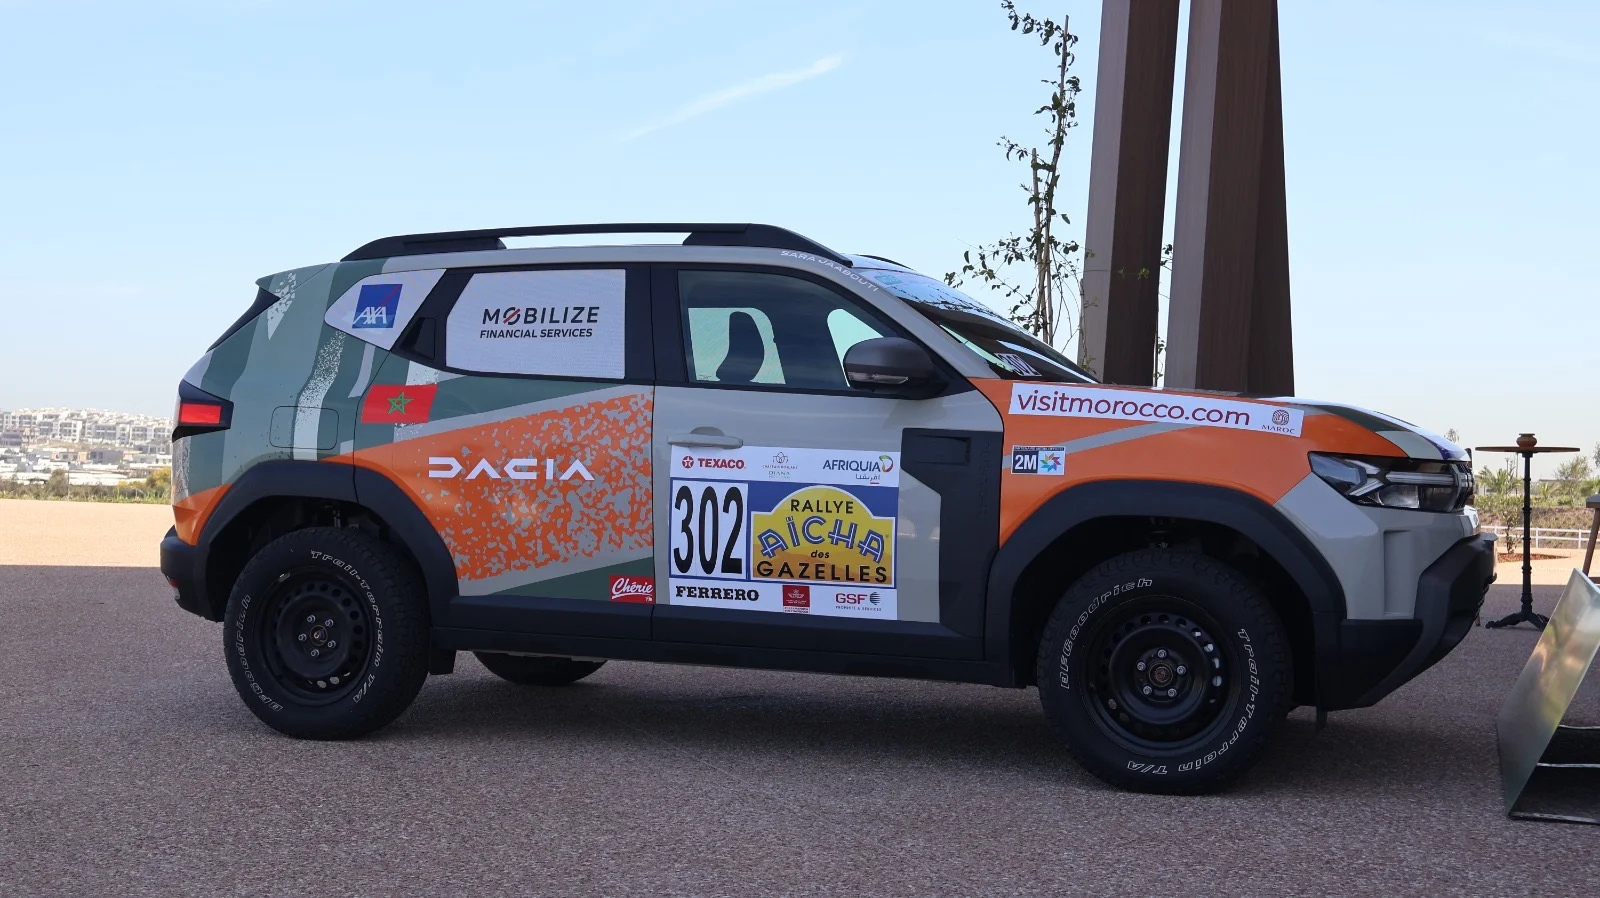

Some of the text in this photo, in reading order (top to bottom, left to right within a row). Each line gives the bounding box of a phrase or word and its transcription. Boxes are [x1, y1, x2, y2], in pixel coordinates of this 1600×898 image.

[781, 250, 815, 262] SARA
[353, 306, 388, 325] AXA
[482, 306, 600, 325] MOBILIZE
[480, 328, 593, 339] FINANCIAL SERVICES
[1017, 389, 1250, 426] visitmorocco.com
[1261, 424, 1296, 435] MAROC
[428, 456, 596, 481] DACIA
[697, 457, 745, 470] TEXACO
[822, 459, 881, 473] AFRIQUIA
[1014, 454, 1037, 470] 2M
[790, 498, 854, 514] RALLYE
[673, 485, 744, 575] 302
[810, 549, 830, 559] des
[756, 560, 888, 583] GAZELLES
[611, 577, 654, 595] Chérie
[675, 585, 760, 601] FERRERO
[835, 592, 868, 605] GSF
[1059, 578, 1153, 689] BFGoodrich
[1127, 628, 1260, 775] Trail-Terrain T/A
